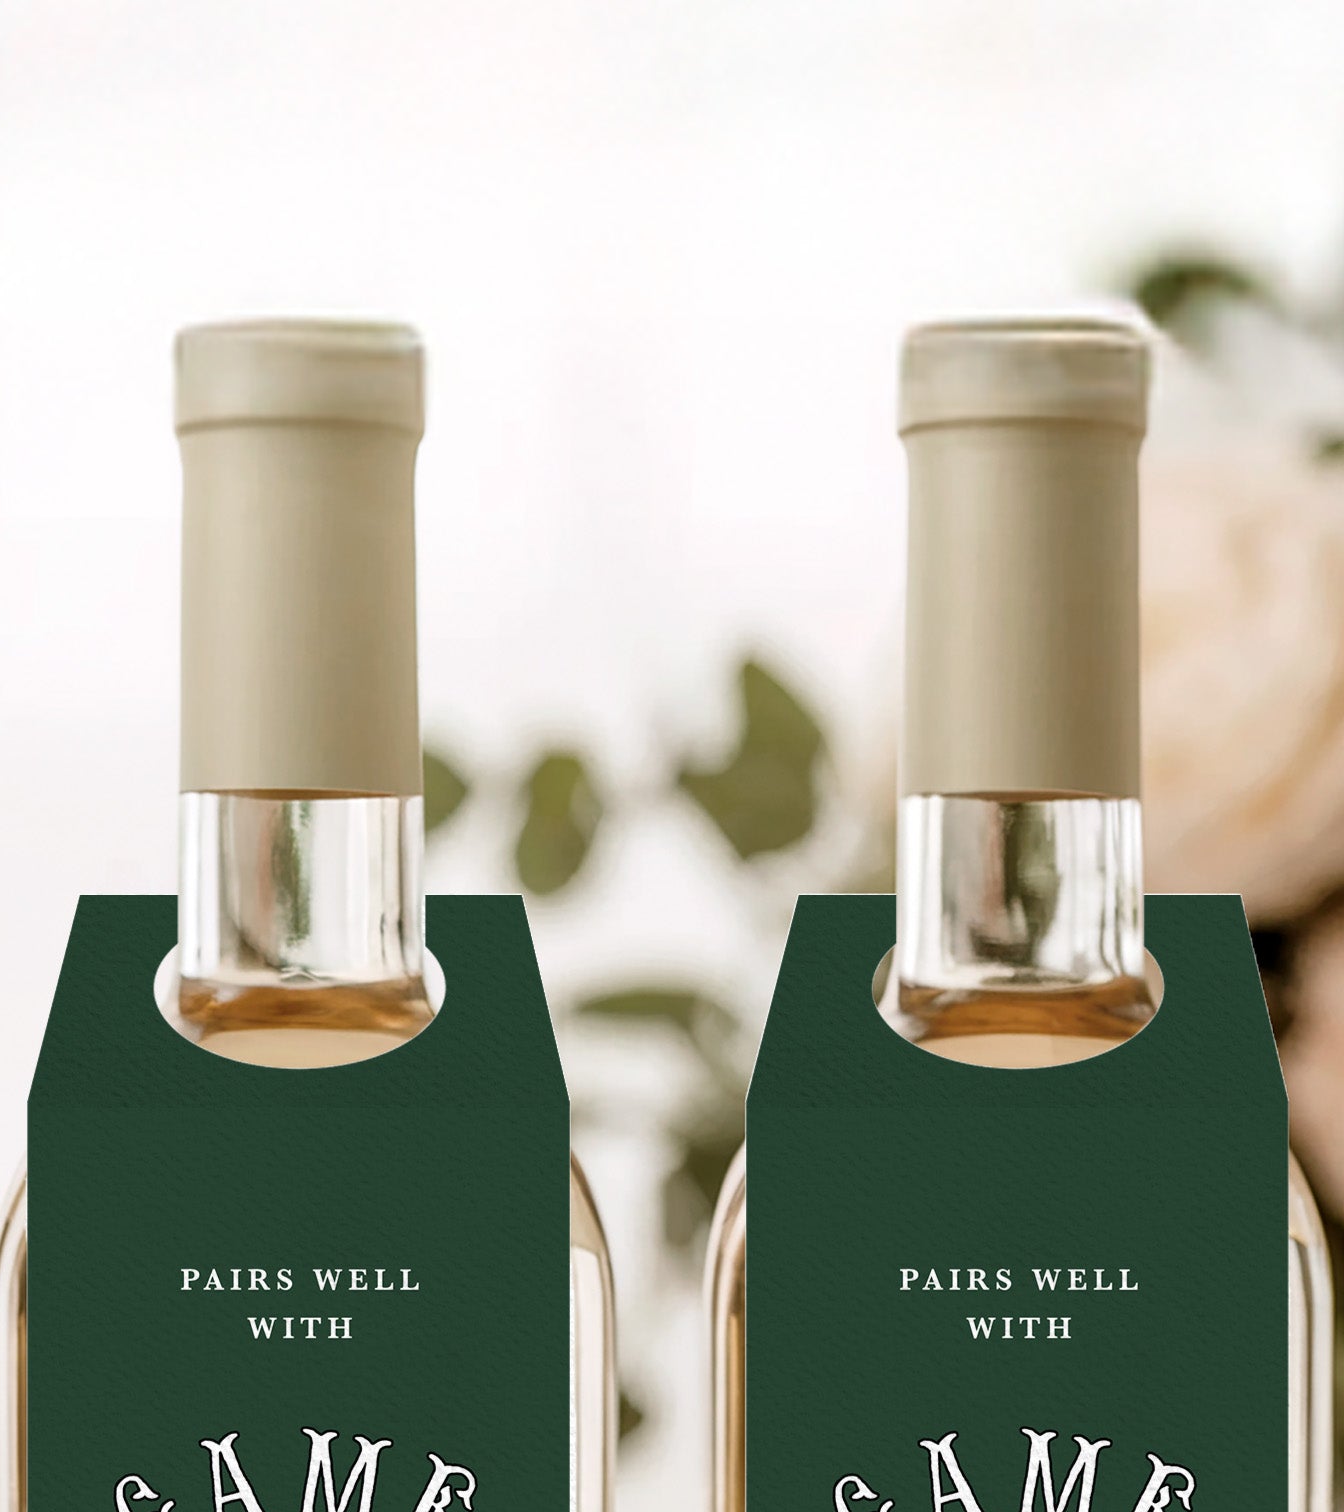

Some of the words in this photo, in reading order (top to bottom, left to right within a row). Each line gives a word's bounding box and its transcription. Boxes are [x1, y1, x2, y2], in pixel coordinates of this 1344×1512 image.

[180, 1268, 293, 1291] PAIRS
[312, 1268, 420, 1291] WELL
[899, 1268, 1012, 1291] PAIRS
[1031, 1268, 1139, 1291] WELL
[246, 1316, 353, 1340] WITH
[965, 1316, 1072, 1340] WITH
